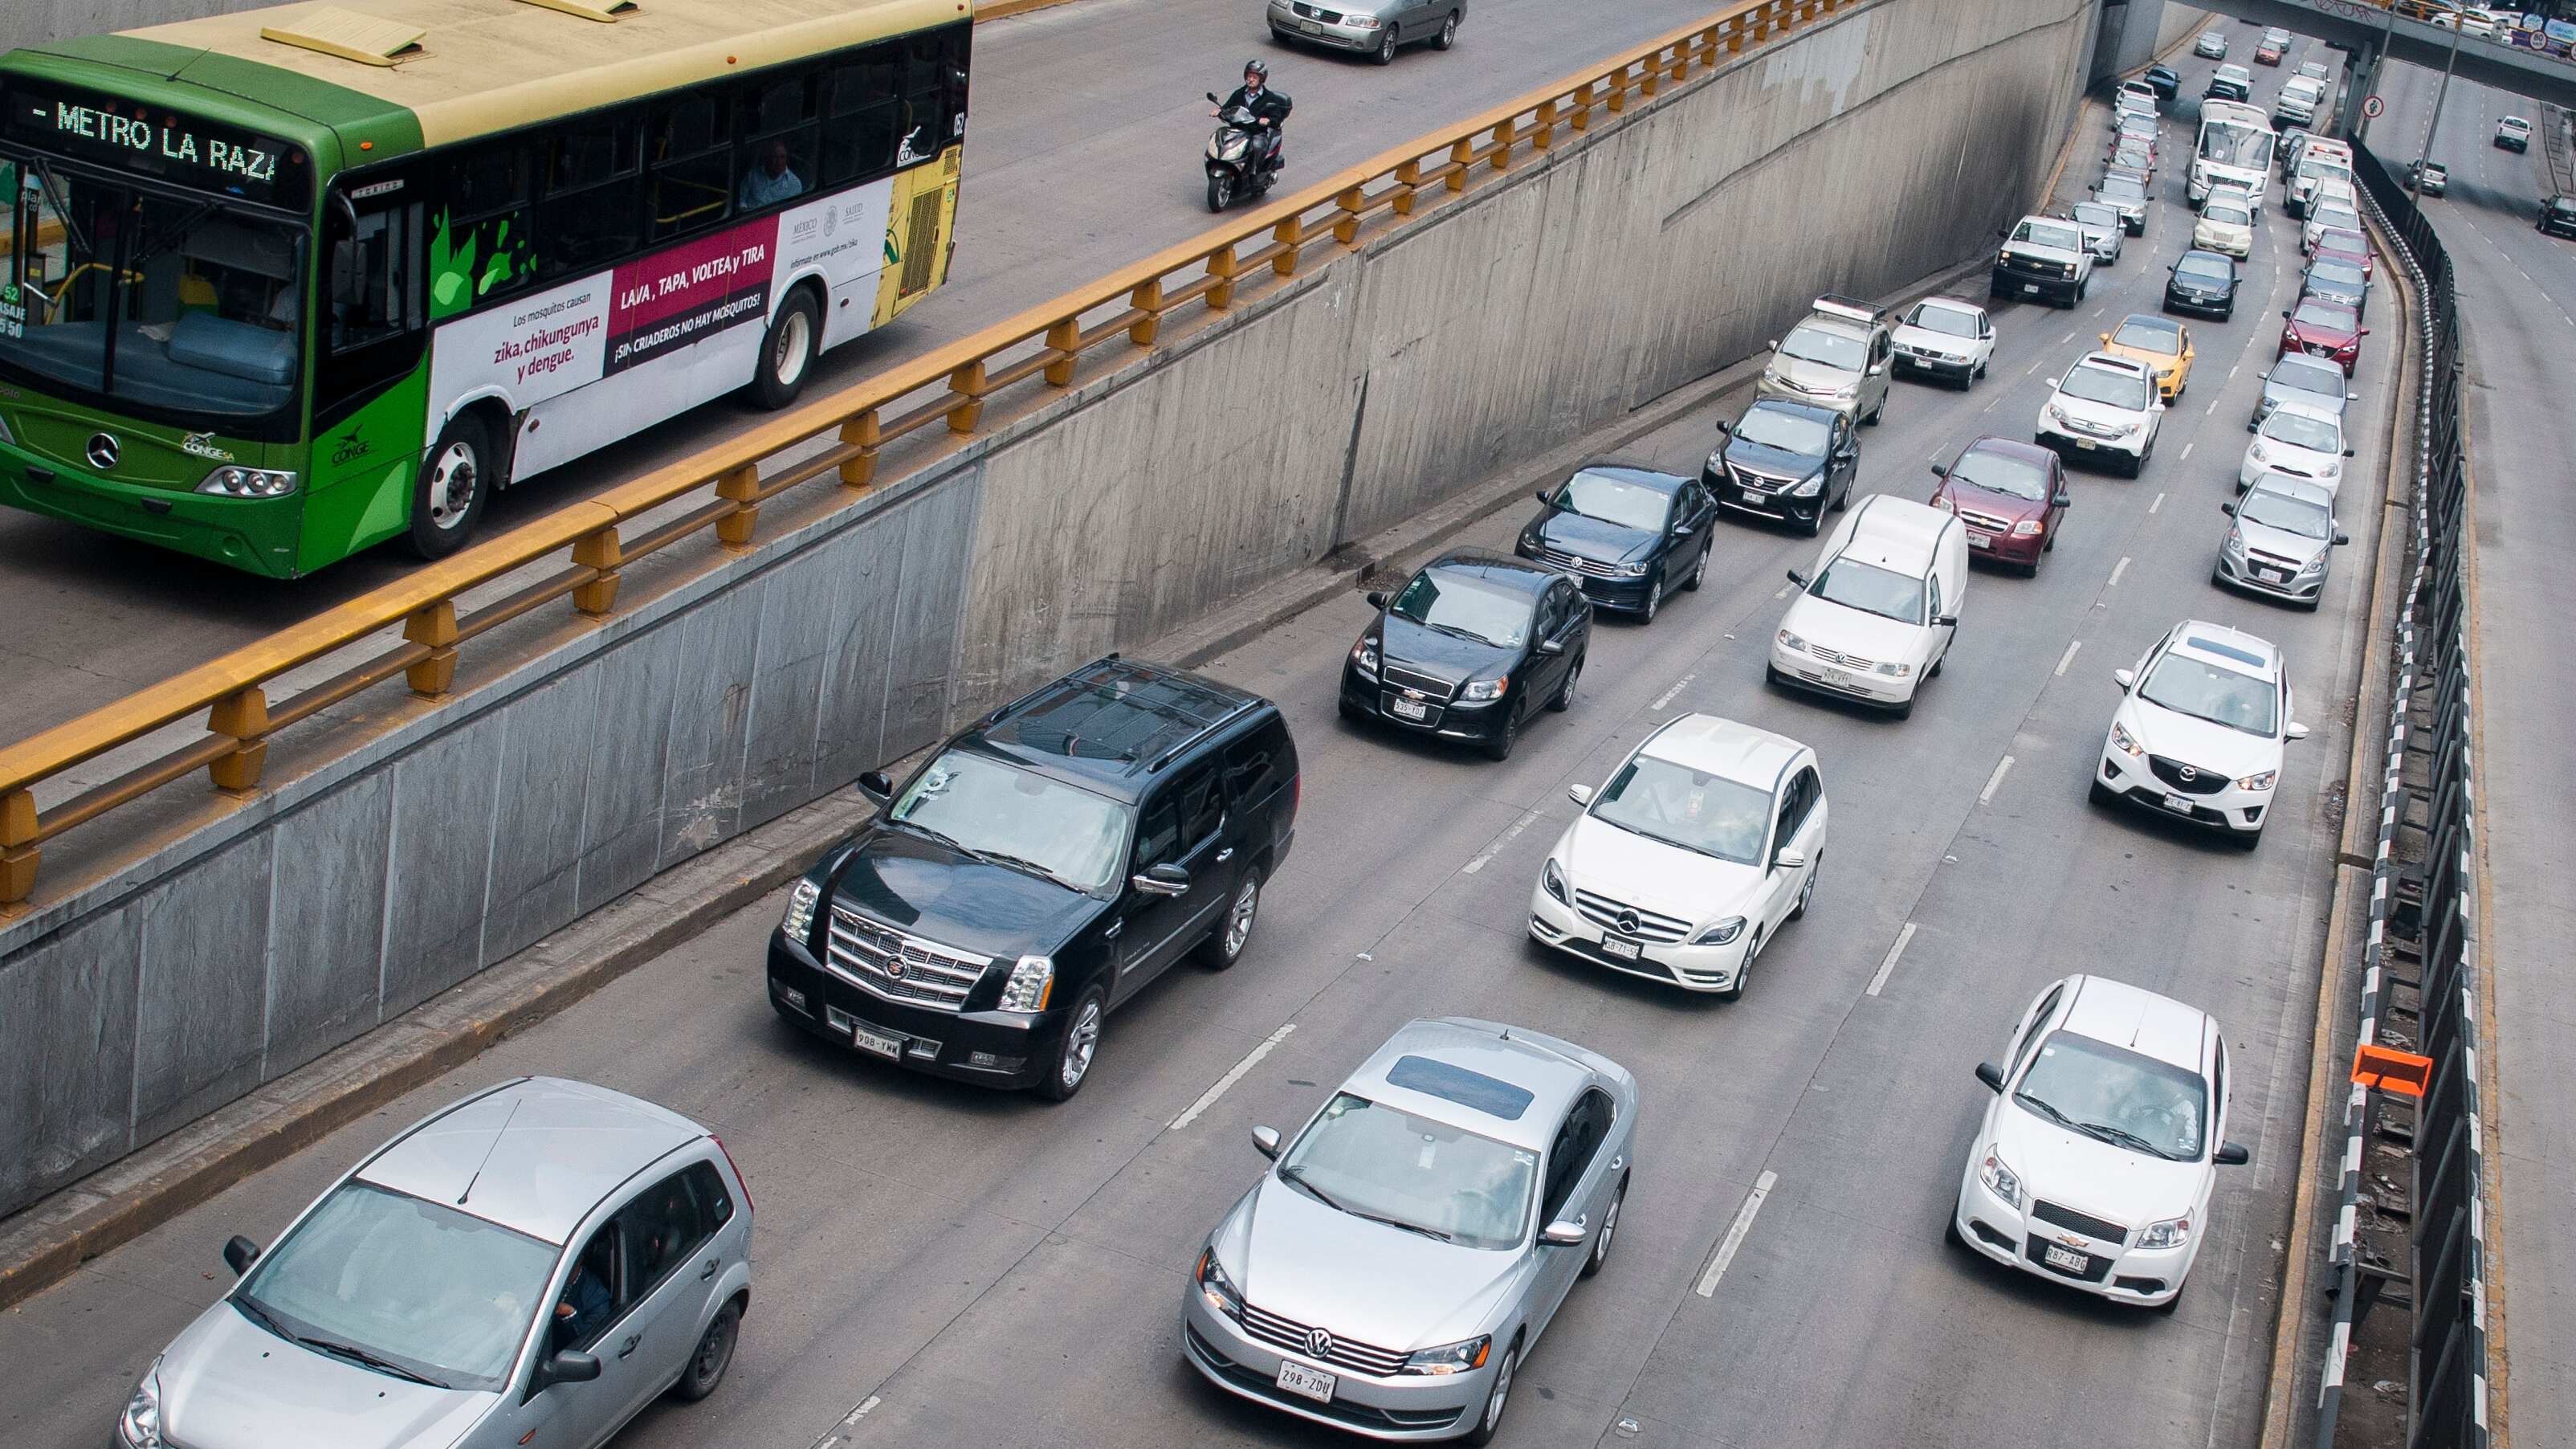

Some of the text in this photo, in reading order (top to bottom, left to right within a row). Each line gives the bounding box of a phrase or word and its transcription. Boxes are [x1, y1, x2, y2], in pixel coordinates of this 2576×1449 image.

[58, 101, 152, 149] METRO
[162, 128, 198, 162] LA
[658, 271, 689, 296] TAPA,
[692, 255, 732, 284] VOLTEA
[732, 256, 740, 275] y
[742, 244, 764, 267] TIRA
[5, 286, 18, 301] 52
[513, 292, 591, 328] Los mosquitos causan
[494, 316, 599, 364] zika, chikungunya
[634, 323, 680, 353] CRIADEROS
[681, 318, 694, 335] NO
[695, 312, 712, 330] HAY
[712, 292, 760, 323] MOSQUITOS!
[517, 348, 574, 385] y dengue.
[1282, 1369, 1331, 1394] 298-ZDU
